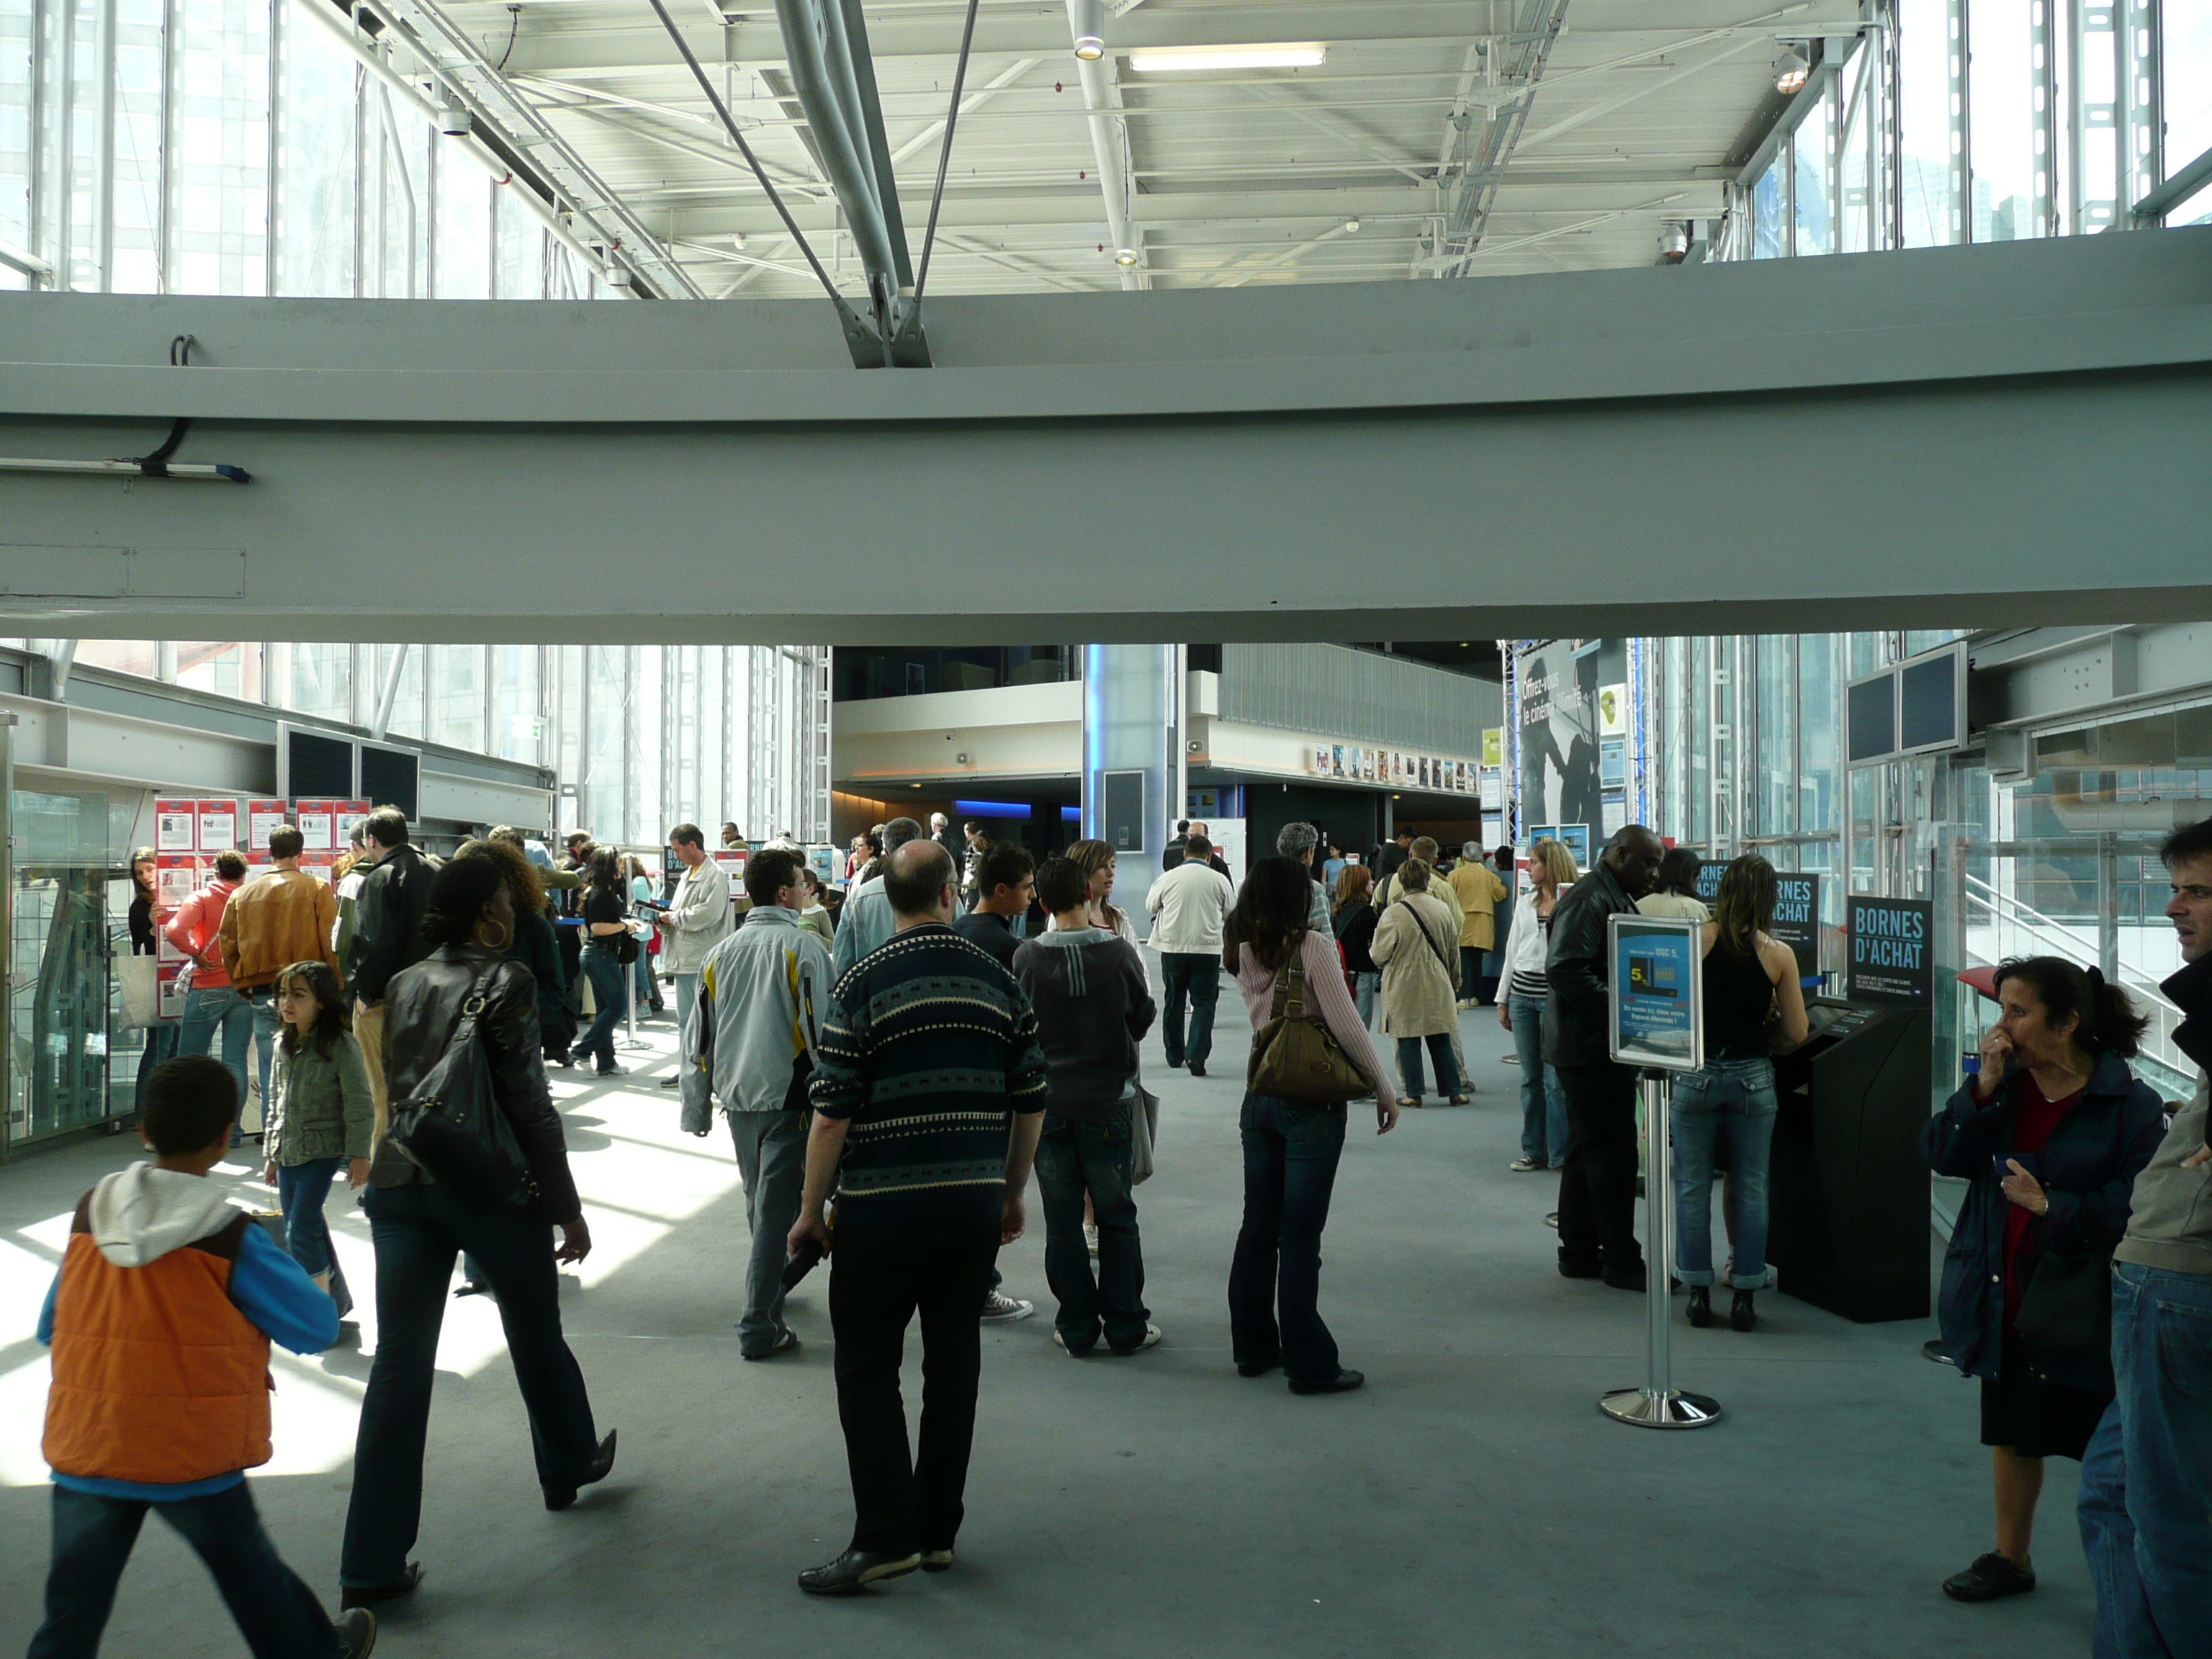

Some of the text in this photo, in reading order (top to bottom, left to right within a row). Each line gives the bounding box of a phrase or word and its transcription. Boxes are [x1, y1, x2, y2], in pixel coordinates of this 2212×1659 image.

[1522, 672, 1559, 700] Offrez-vous
[1523, 706, 1530, 726] le
[1531, 698, 1555, 723] cinéma
[1556, 685, 1582, 714] illimité
[1776, 880, 1811, 902] RNES
[1856, 907, 1923, 940] BORNES
[1655, 948, 1670, 956] UGC
[1671, 949, 1678, 958] 5,
[1855, 938, 1923, 970] D'ACHAT
[1650, 1014, 1673, 1023] Abonnés
